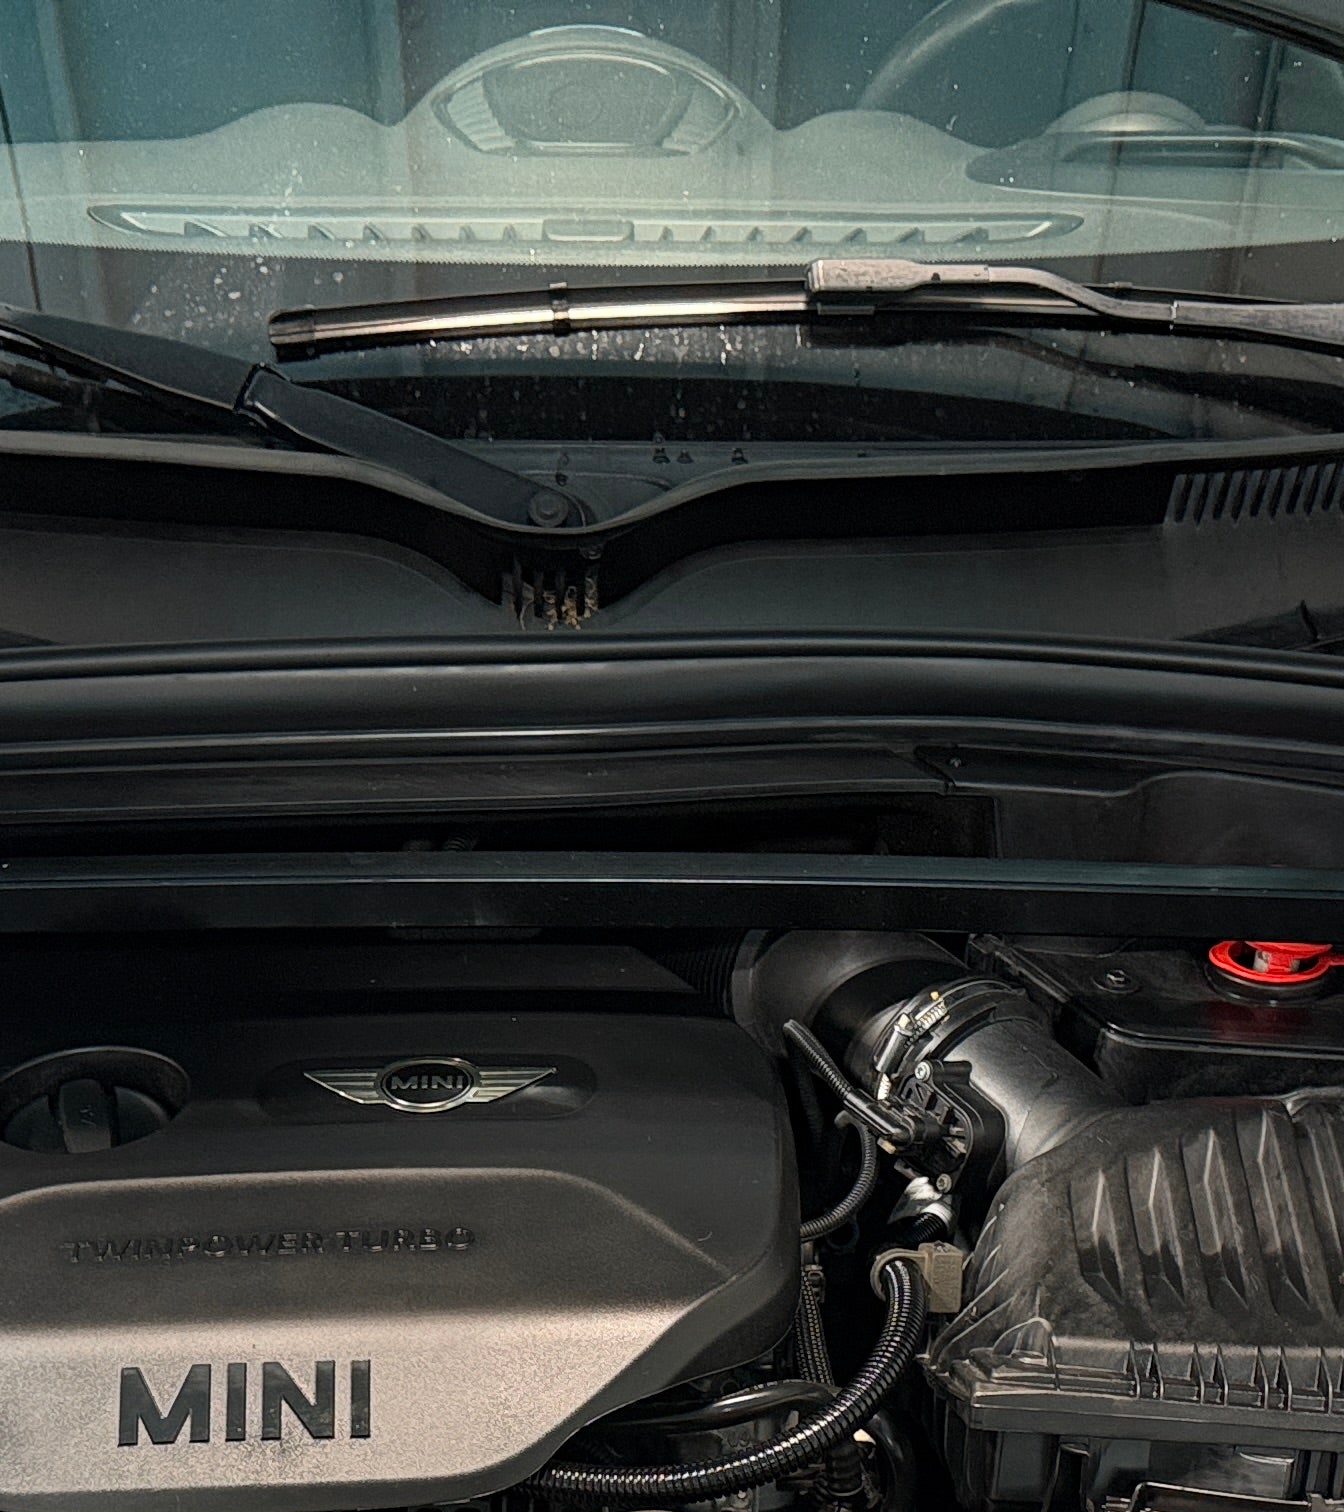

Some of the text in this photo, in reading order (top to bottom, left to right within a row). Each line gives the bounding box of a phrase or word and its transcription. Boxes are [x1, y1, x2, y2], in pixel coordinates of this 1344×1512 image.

[390, 1075, 464, 1090] MINI
[59, 1226, 476, 1263] TWINPOWER TURBO
[117, 1359, 371, 1448] MINI
